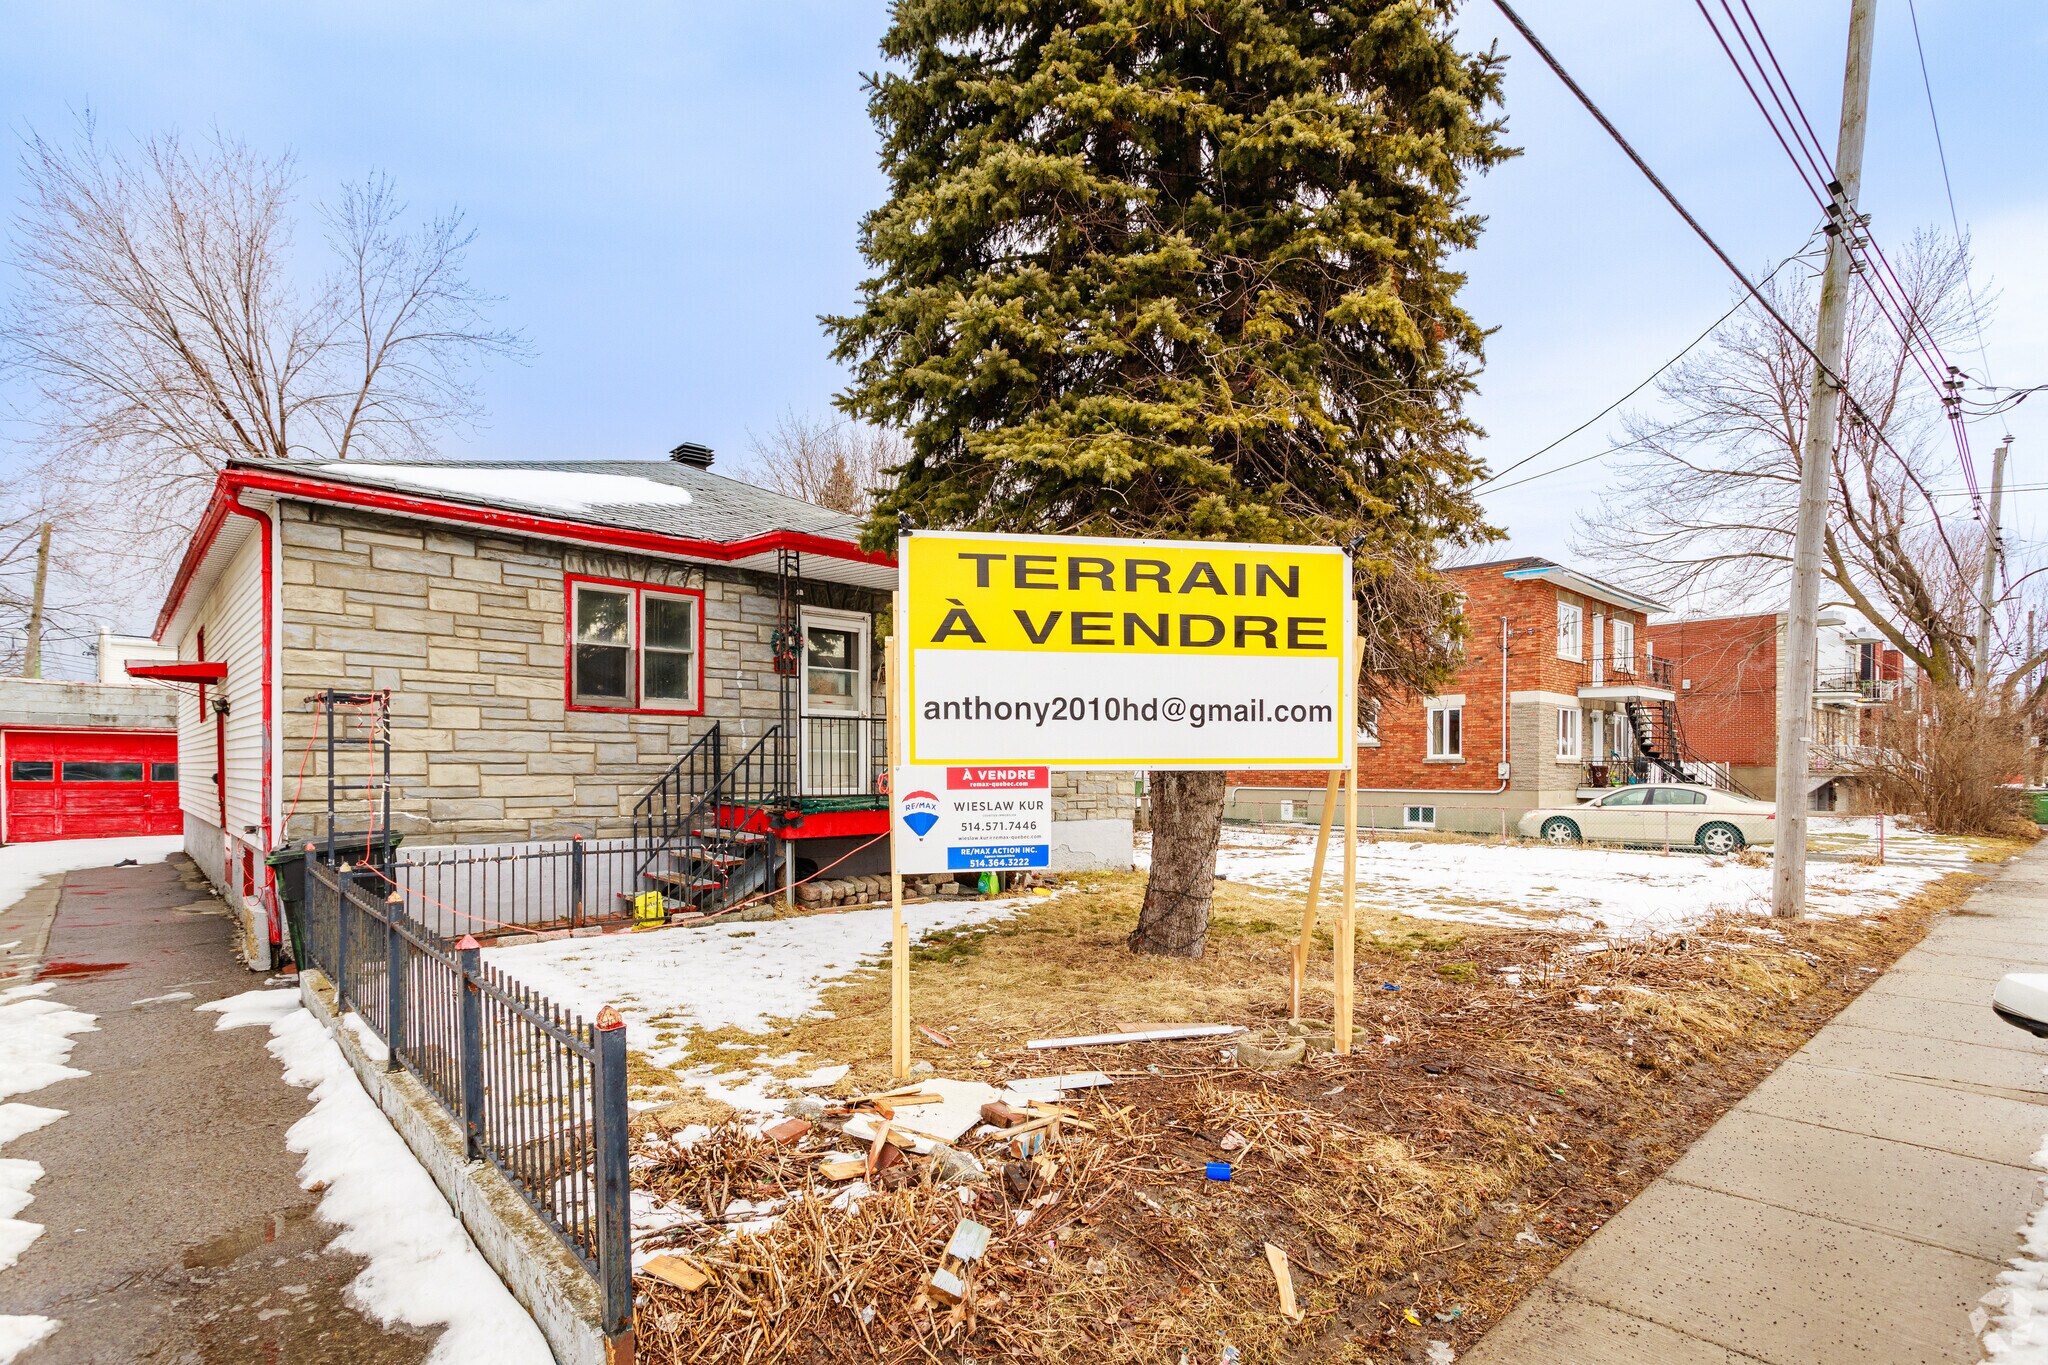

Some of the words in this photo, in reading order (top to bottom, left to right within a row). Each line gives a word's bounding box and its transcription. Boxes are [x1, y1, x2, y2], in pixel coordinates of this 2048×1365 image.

[958, 552, 1300, 598] TERRAIN
[930, 598, 986, 643] À
[1013, 609, 1327, 650] VENDRE
[923, 695, 1333, 728] anthony2010hd@gmail.com
[962, 768, 973, 781] À
[977, 769, 1036, 780] VENDRE
[905, 802, 937, 811] RE/MAX
[953, 801, 1015, 812] WIESLAW
[1019, 800, 1044, 811] KUR
[961, 820, 1037, 832] 514.571.7446
[992, 847, 1021, 855] ACTION
[1022, 846, 1038, 854] INC.
[969, 858, 1030, 868] 514.364.3222
